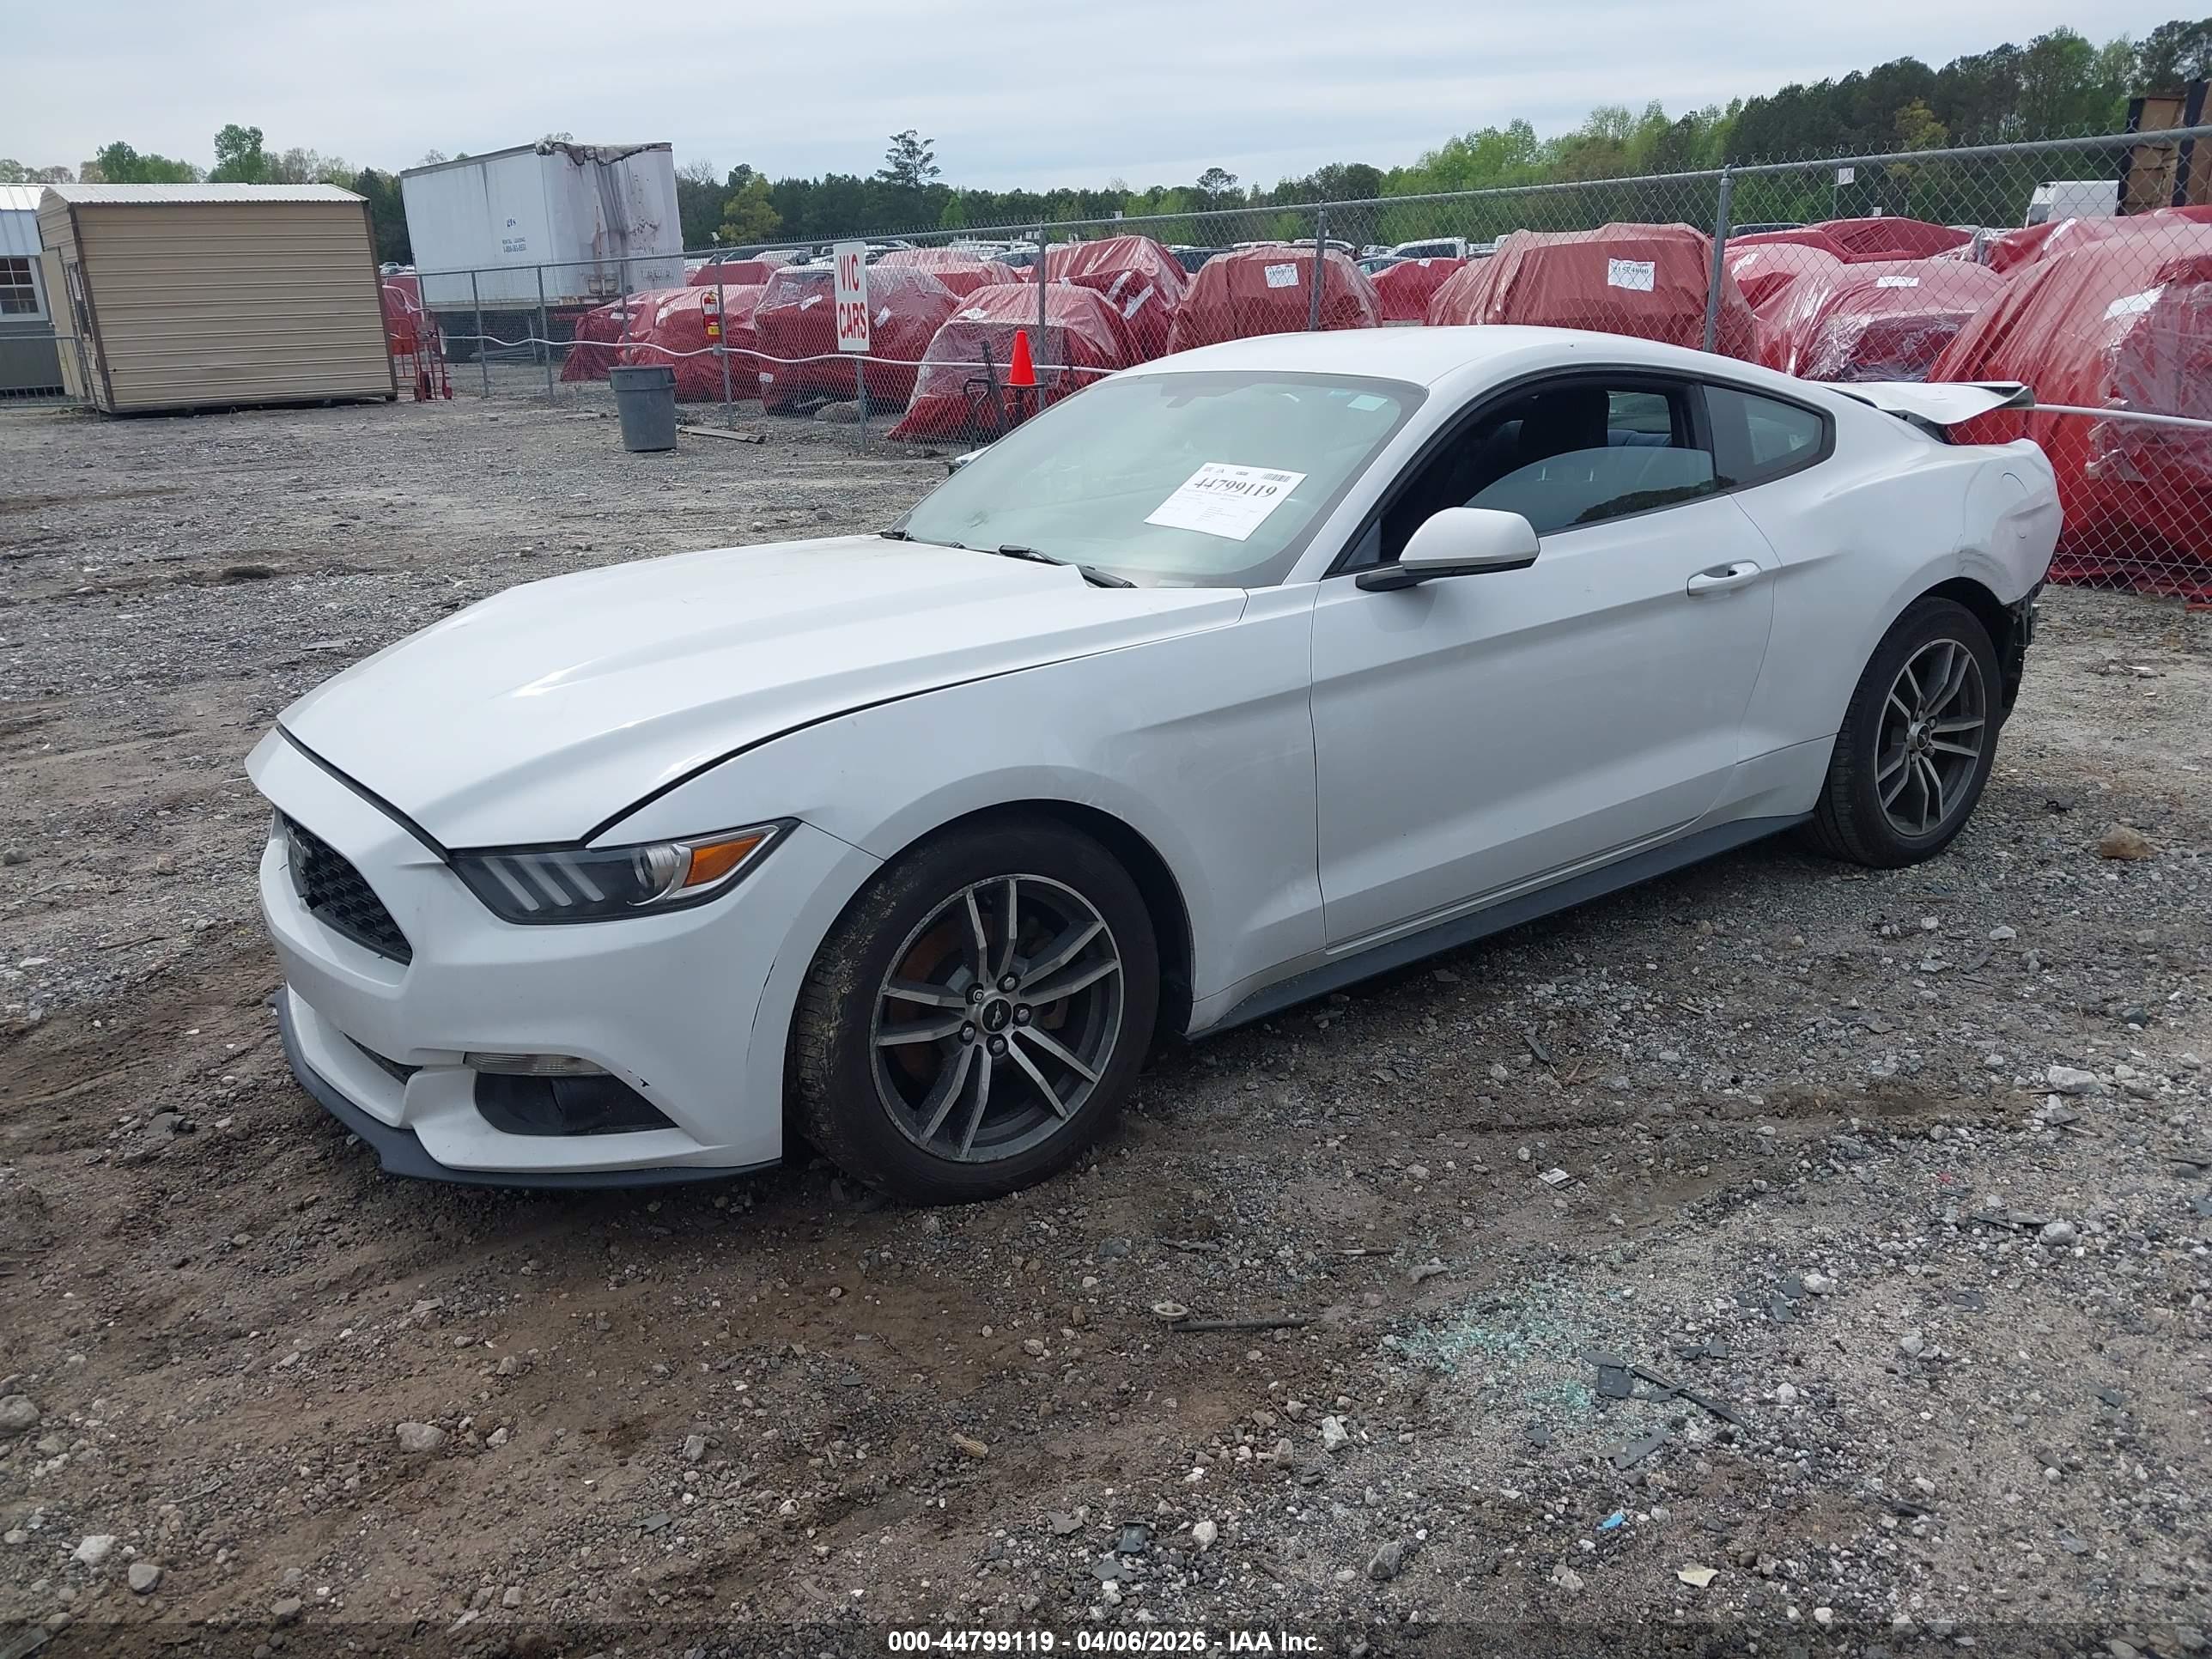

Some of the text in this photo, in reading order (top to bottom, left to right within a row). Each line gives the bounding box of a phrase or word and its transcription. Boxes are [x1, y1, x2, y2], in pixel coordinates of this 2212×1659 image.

[839, 253, 860, 292] VIC
[839, 301, 867, 340] CARS
[1194, 477, 1278, 498] 44799119
